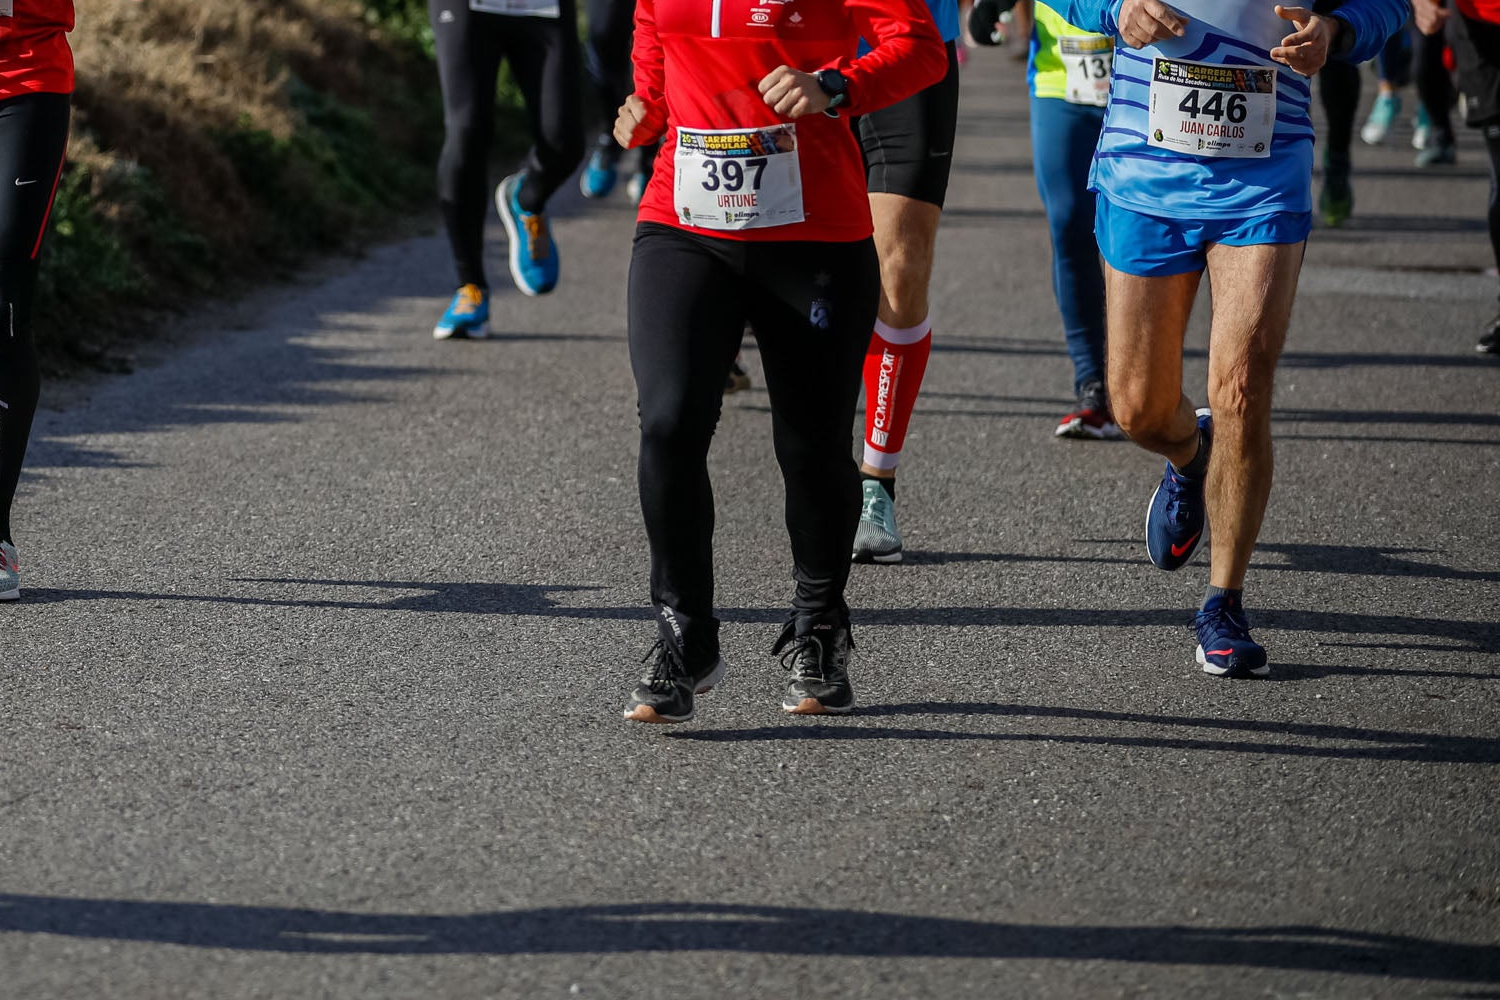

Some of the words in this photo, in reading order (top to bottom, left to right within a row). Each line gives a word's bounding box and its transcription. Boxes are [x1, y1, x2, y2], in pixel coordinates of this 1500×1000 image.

[1078, 57, 1113, 80] 13
[1187, 65, 1233, 77] CARRERA
[1187, 73, 1233, 83] POPULAR
[1178, 89, 1247, 124] 446
[1180, 120, 1204, 136] JUAN
[1206, 123, 1245, 139] CARLOS
[703, 134, 748, 143] CARRERA
[701, 158, 768, 192] 397
[717, 194, 758, 208] URTUNE
